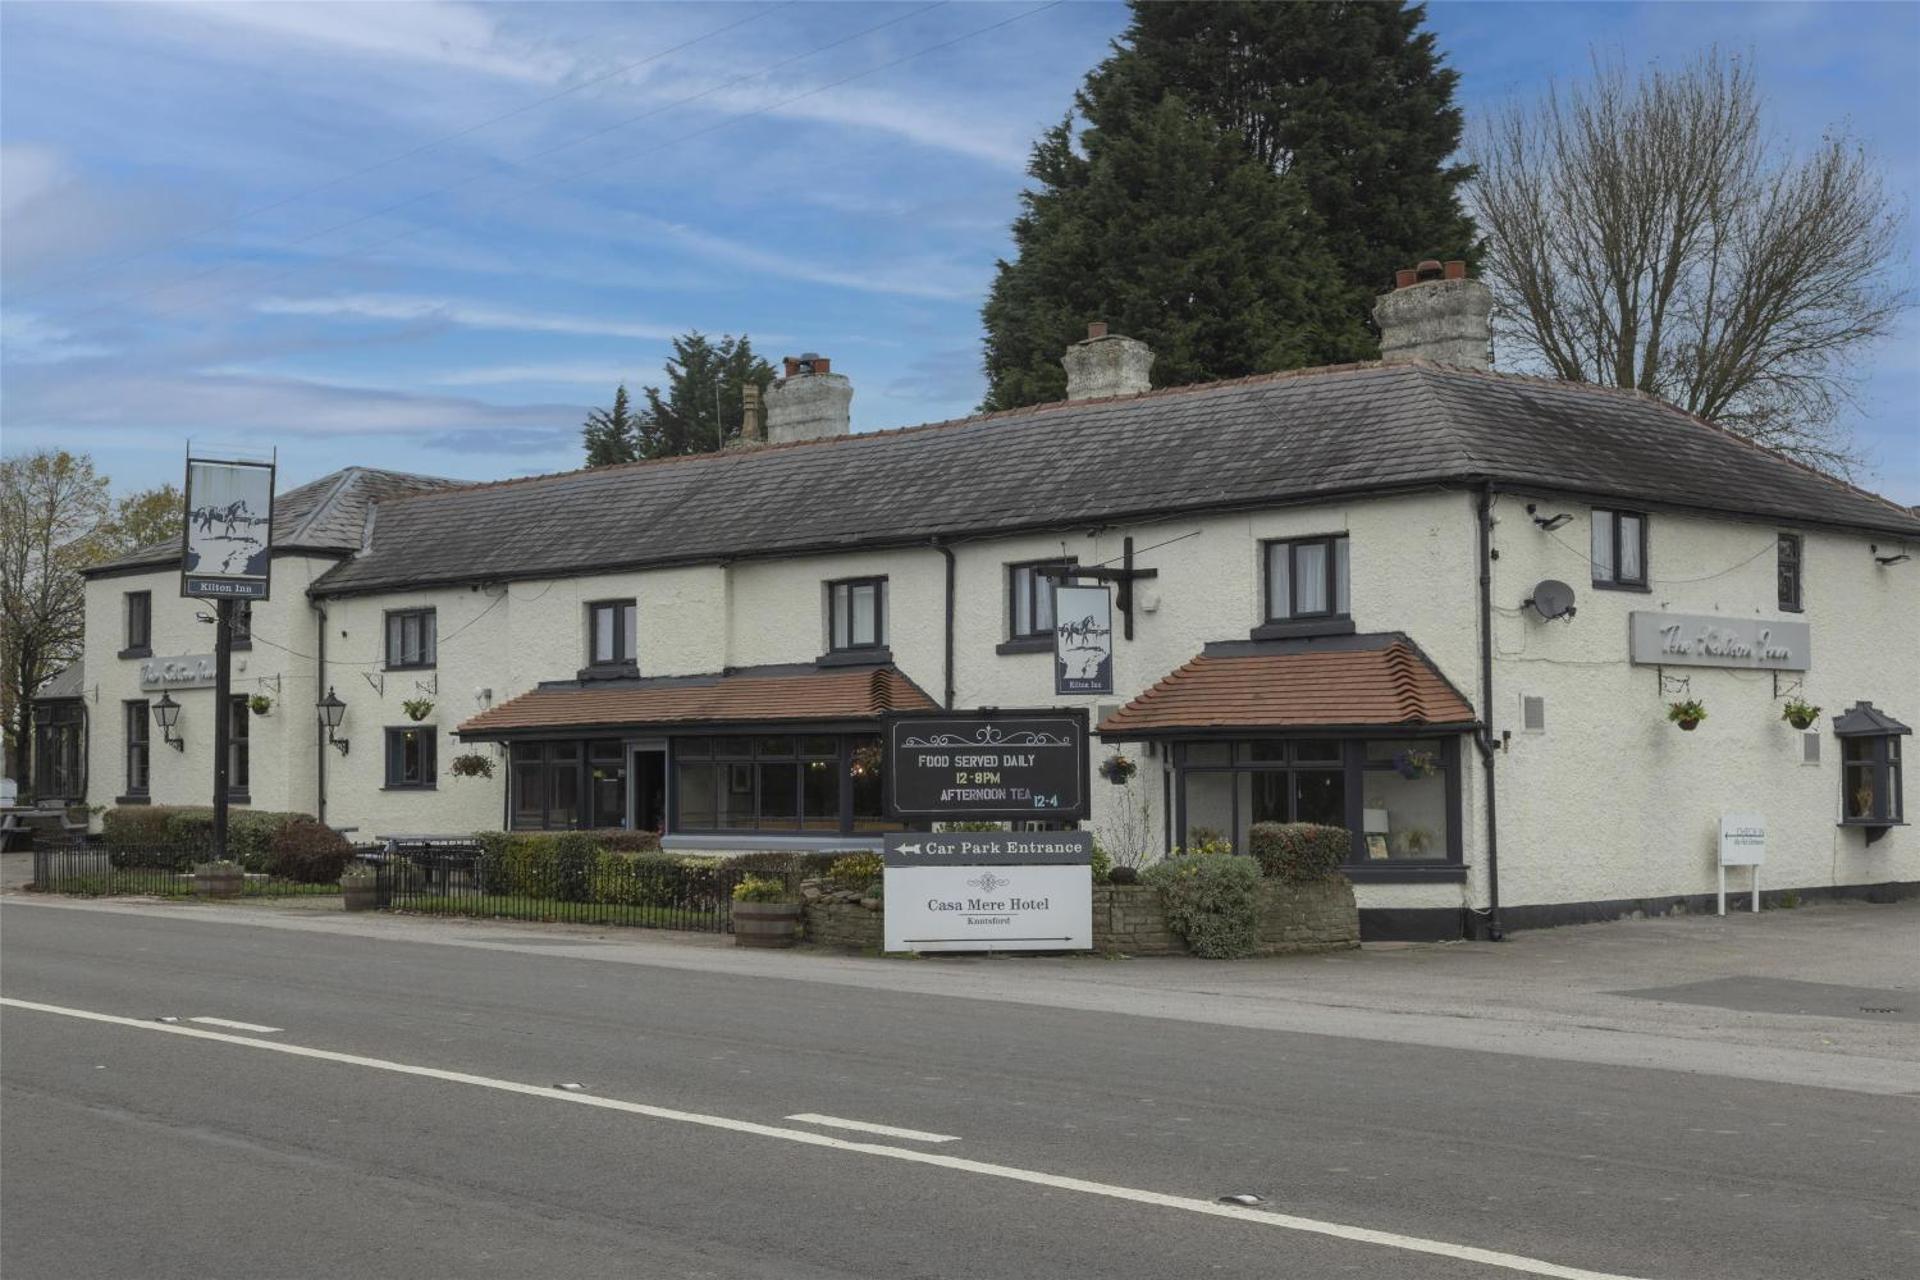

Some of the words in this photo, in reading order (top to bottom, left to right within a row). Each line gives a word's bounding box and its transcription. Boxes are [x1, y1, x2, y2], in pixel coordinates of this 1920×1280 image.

[200, 583, 232, 592] Kilton
[235, 585, 252, 593] Inn
[1660, 624, 1692, 657] The
[1756, 628, 1793, 662] Inn
[918, 754, 950, 768] FOOD
[954, 754, 998, 768] SERVED
[1003, 753, 1036, 767] DAILY
[940, 788, 1006, 801] AFTERNOON
[1010, 787, 1032, 800] TEA
[1033, 794, 1058, 808] 12-4
[925, 842, 955, 855] Car
[961, 841, 1001, 854] Park
[1006, 841, 1082, 854] Entrance
[928, 899, 963, 912] Casa
[967, 898, 1006, 911] Mere
[1009, 897, 1050, 911] Hotel
[967, 916, 1011, 926] Knutsford
